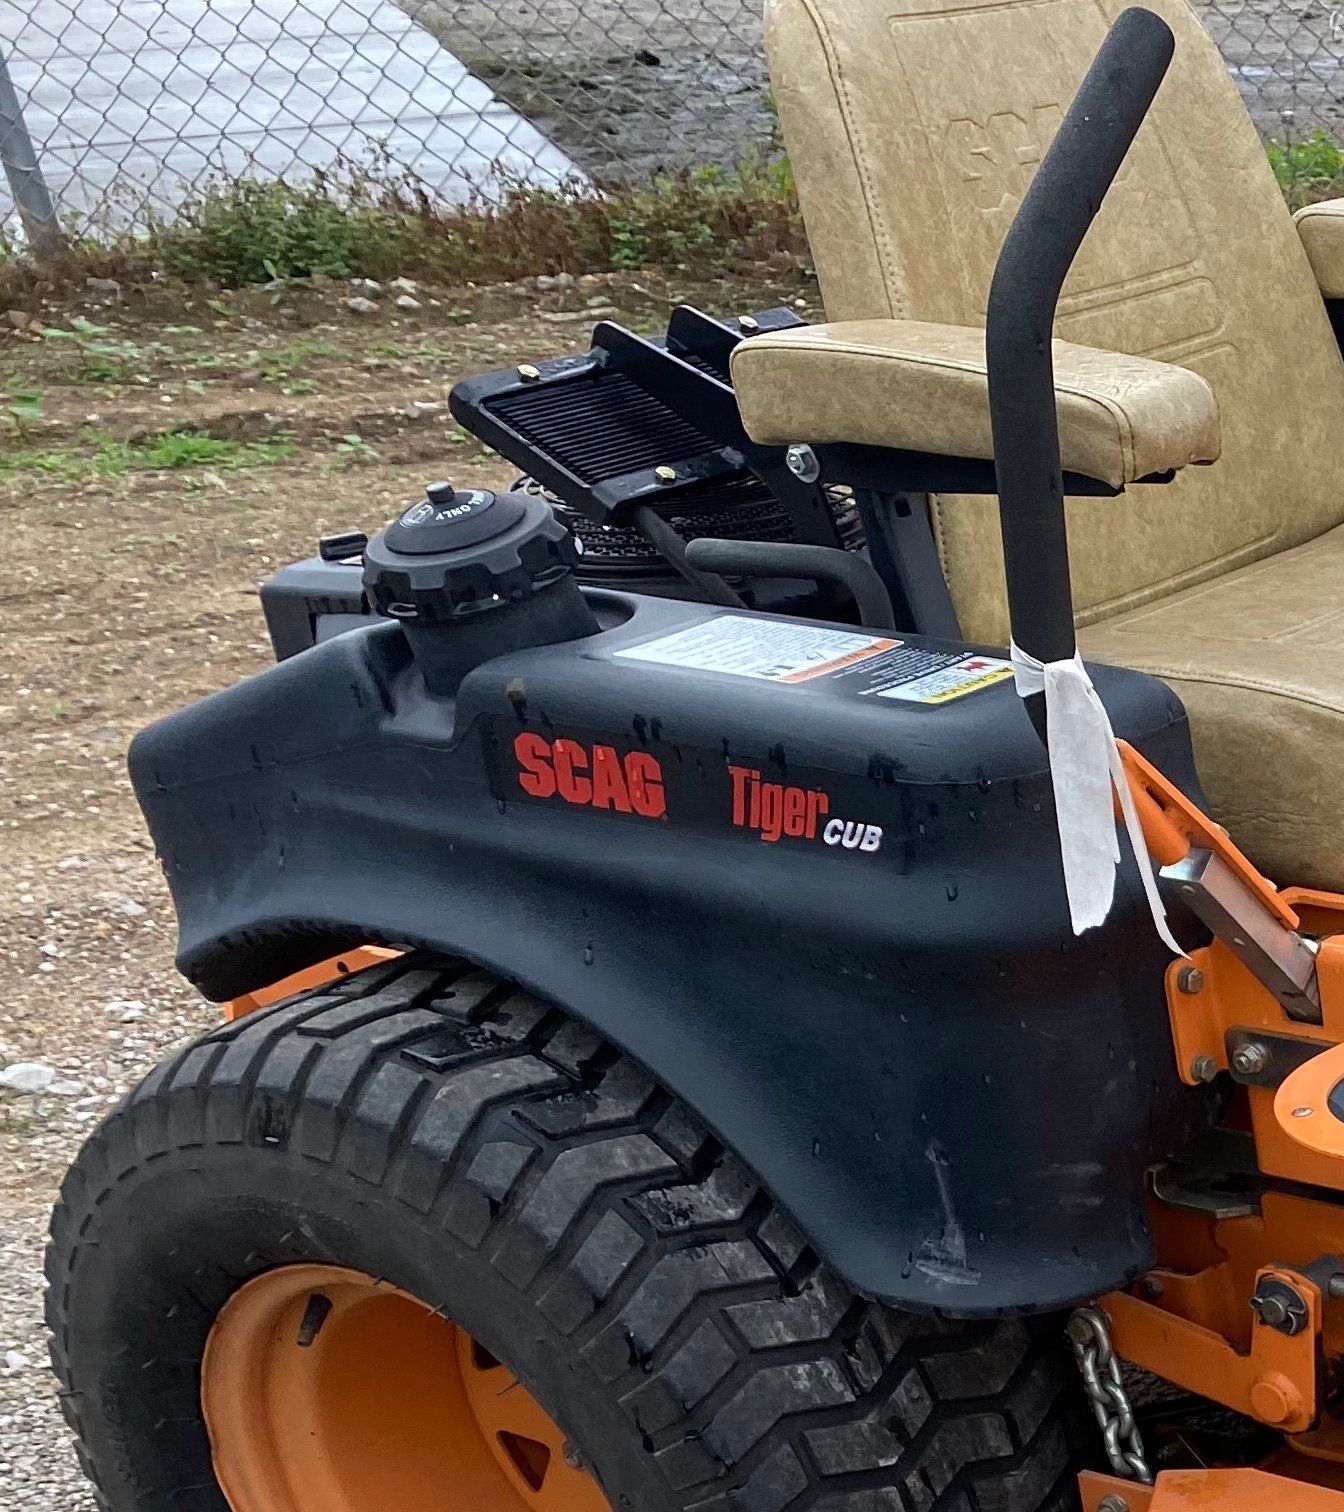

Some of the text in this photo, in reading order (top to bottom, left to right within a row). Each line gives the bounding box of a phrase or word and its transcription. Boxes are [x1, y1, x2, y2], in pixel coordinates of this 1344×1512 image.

[514, 732, 667, 819] SCAG
[727, 765, 883, 852] Tiger CUB
